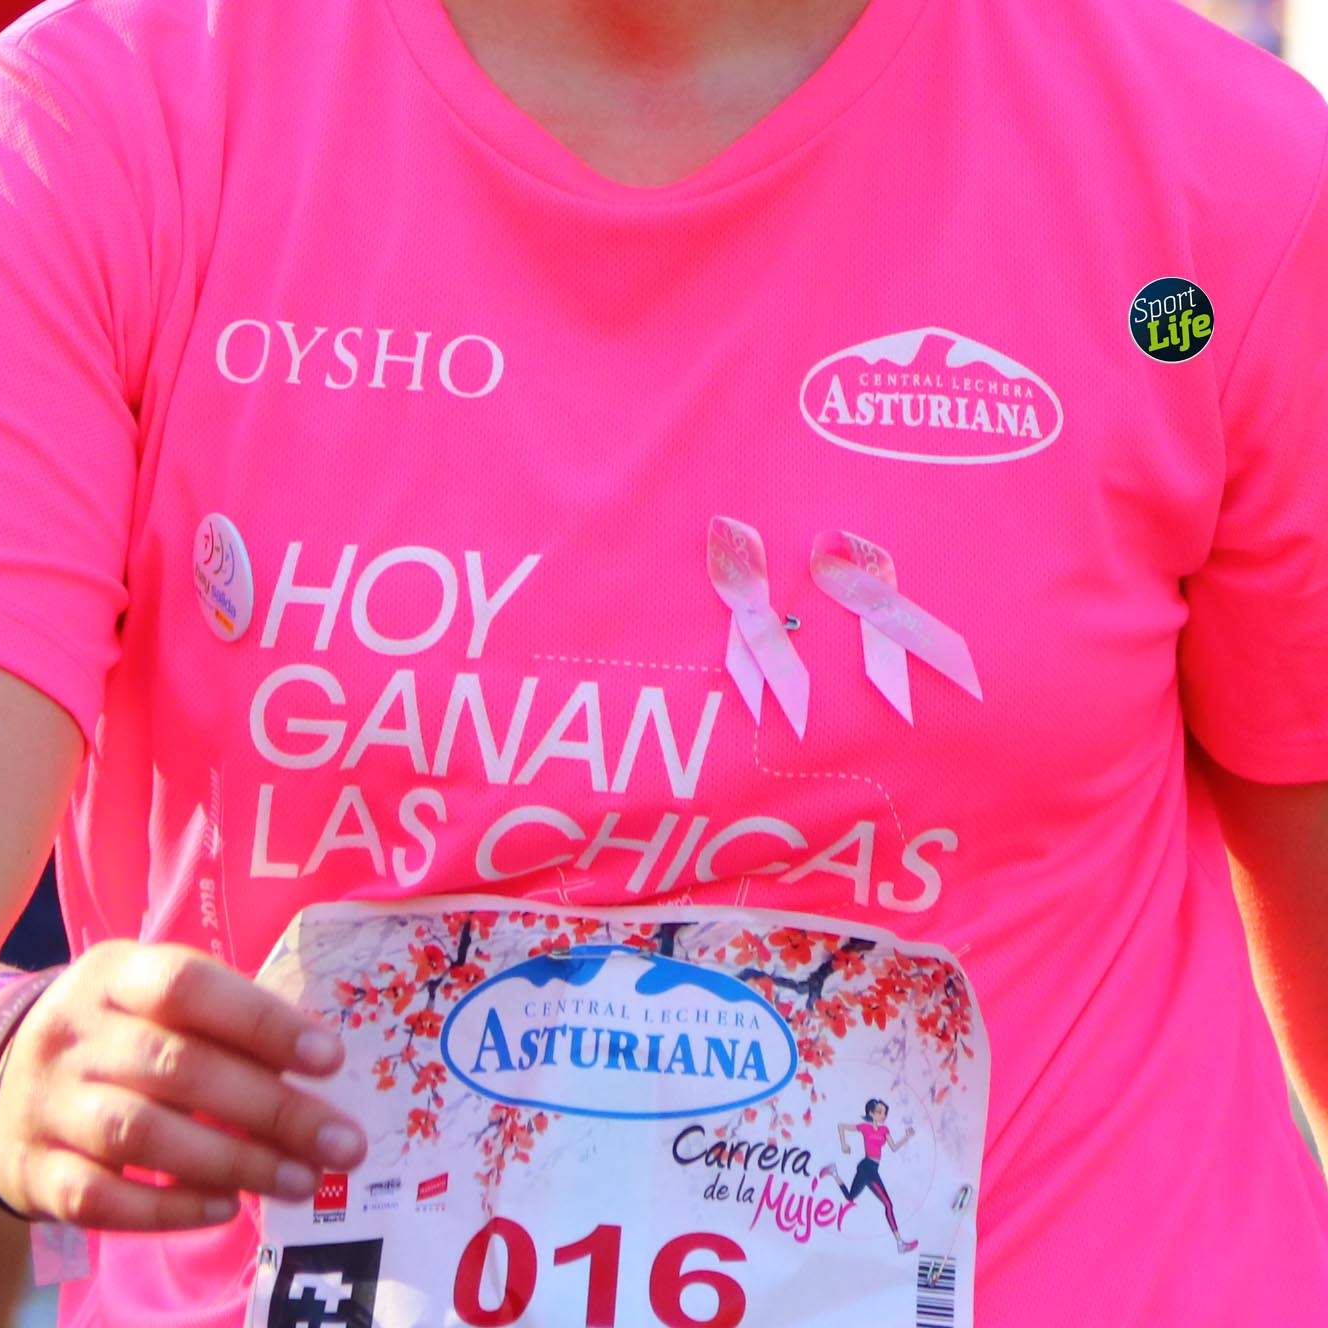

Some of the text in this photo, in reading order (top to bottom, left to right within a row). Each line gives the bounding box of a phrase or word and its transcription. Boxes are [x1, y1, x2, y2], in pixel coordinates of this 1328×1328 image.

[1134, 286, 1197, 323] Sport
[1147, 309, 1212, 352] Life
[215, 319, 505, 399] OYSHO
[859, 372, 1034, 399] CENTRAL LECHERA
[817, 374, 1043, 439] ASTURIANA
[260, 541, 543, 659] HOY
[249, 663, 723, 800] GANAN
[251, 784, 448, 889] LAS
[475, 805, 959, 914] CHICAS
[470, 1007, 771, 1083] ASTURIANA
[523, 998, 761, 1030] CENTRAL LECHERA
[672, 1125, 811, 1178] Carrera
[703, 1173, 857, 1244] de la Mujer
[452, 1215, 748, 1328] 016
